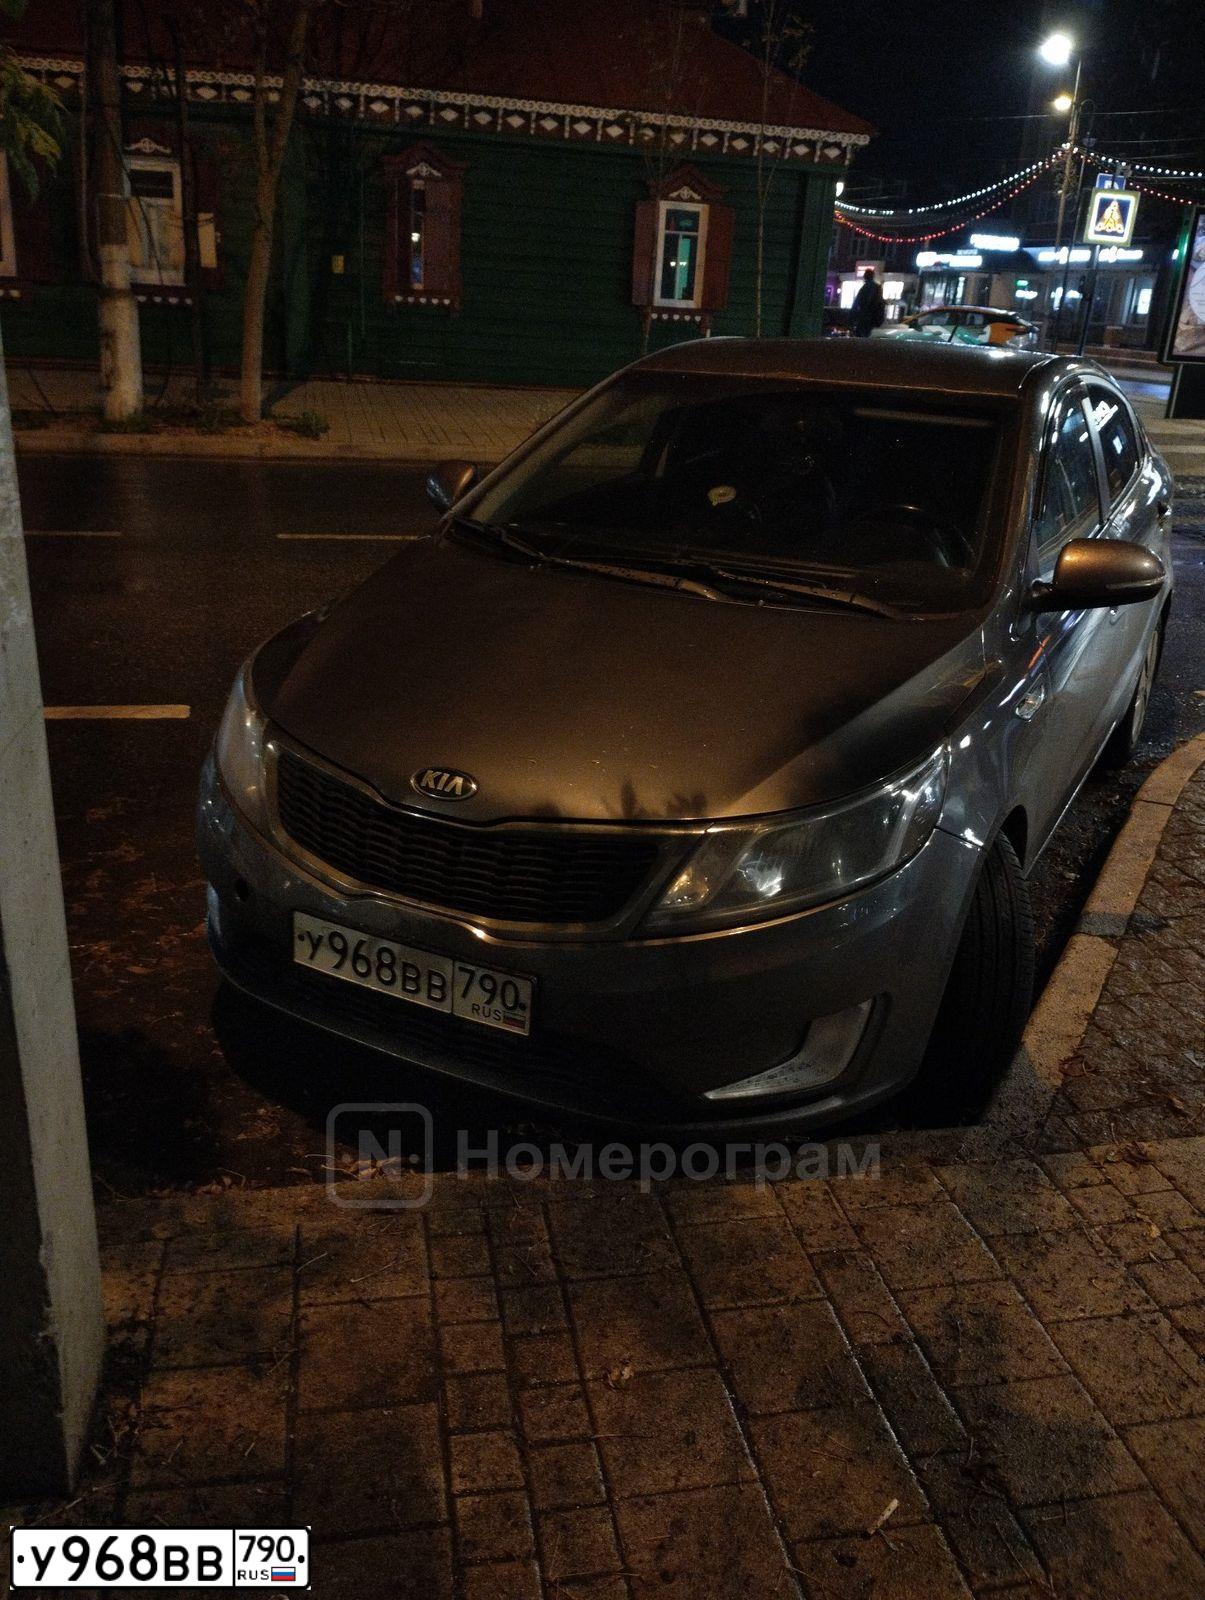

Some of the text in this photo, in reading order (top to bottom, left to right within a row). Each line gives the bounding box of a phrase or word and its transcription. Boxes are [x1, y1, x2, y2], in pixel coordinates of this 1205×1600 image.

[421, 769, 464, 796] KIA
[458, 966, 520, 1011] 790
[471, 1002, 501, 1021] RUS
